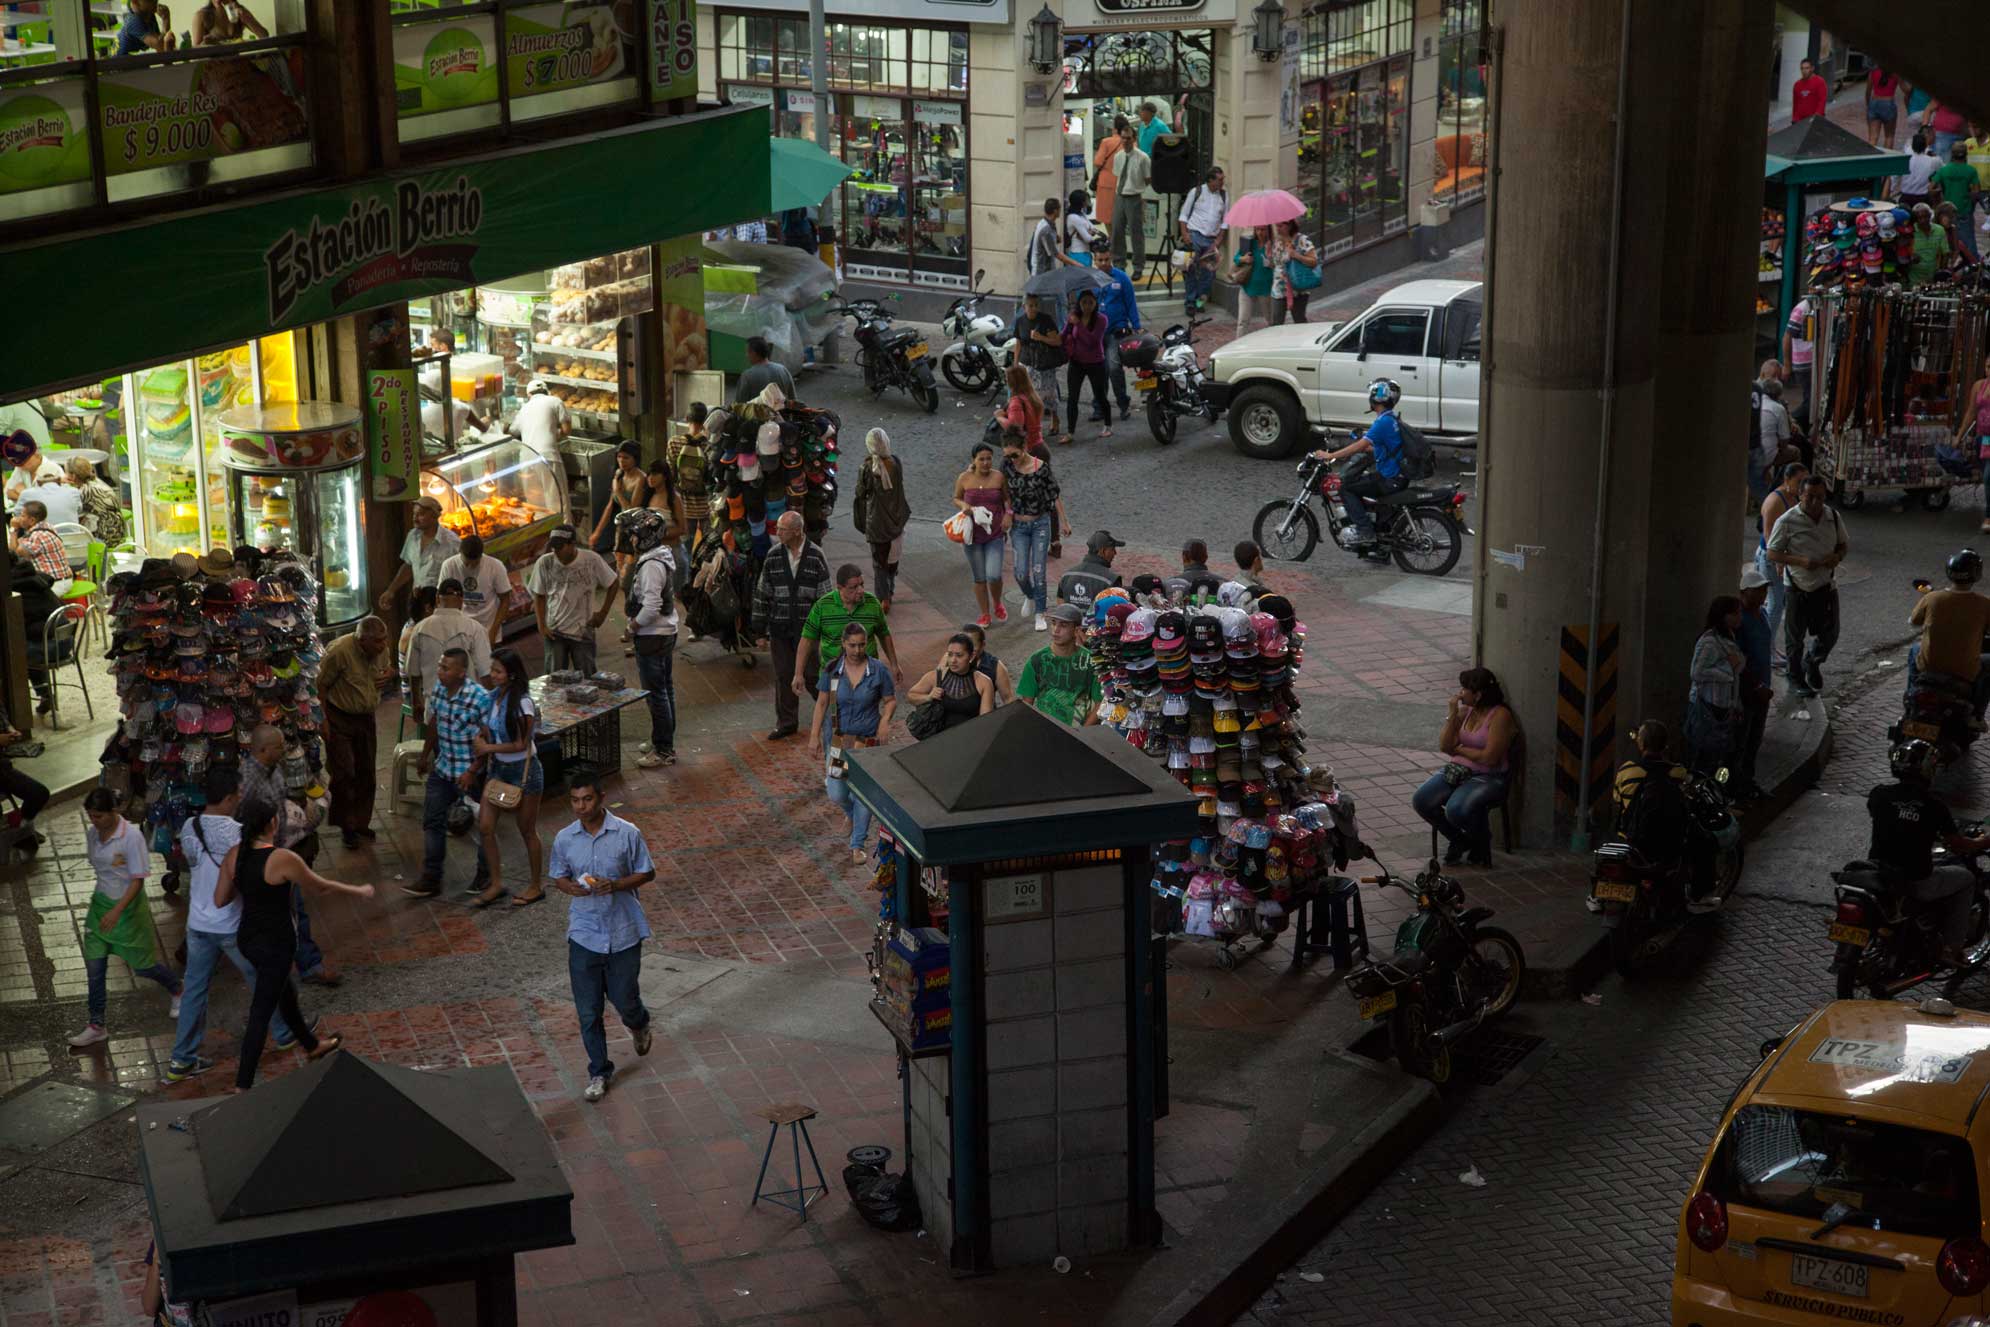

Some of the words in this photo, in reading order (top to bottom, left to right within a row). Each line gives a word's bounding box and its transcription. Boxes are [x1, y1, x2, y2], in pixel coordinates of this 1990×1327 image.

[506, 26, 584, 57] Almuerzos
[523, 61, 535, 87] $
[537, 49, 594, 85] 7.000
[105, 102, 168, 127] Bandeja
[170, 98, 189, 117] de
[191, 93, 218, 113] Res
[123, 126, 138, 163] $
[145, 117, 214, 159] 9.000
[266, 194, 393, 325] Estación
[370, 375, 401, 398] 2do
[378, 401, 391, 464] PISO
[400, 389, 413, 477] RESTAURANTE
[1015, 883, 1036, 895] 100
[1824, 1040, 1880, 1059] TPZ
[1763, 1289, 1836, 1317] SERVICIO
[1838, 1302, 1905, 1326] PUBLICO
